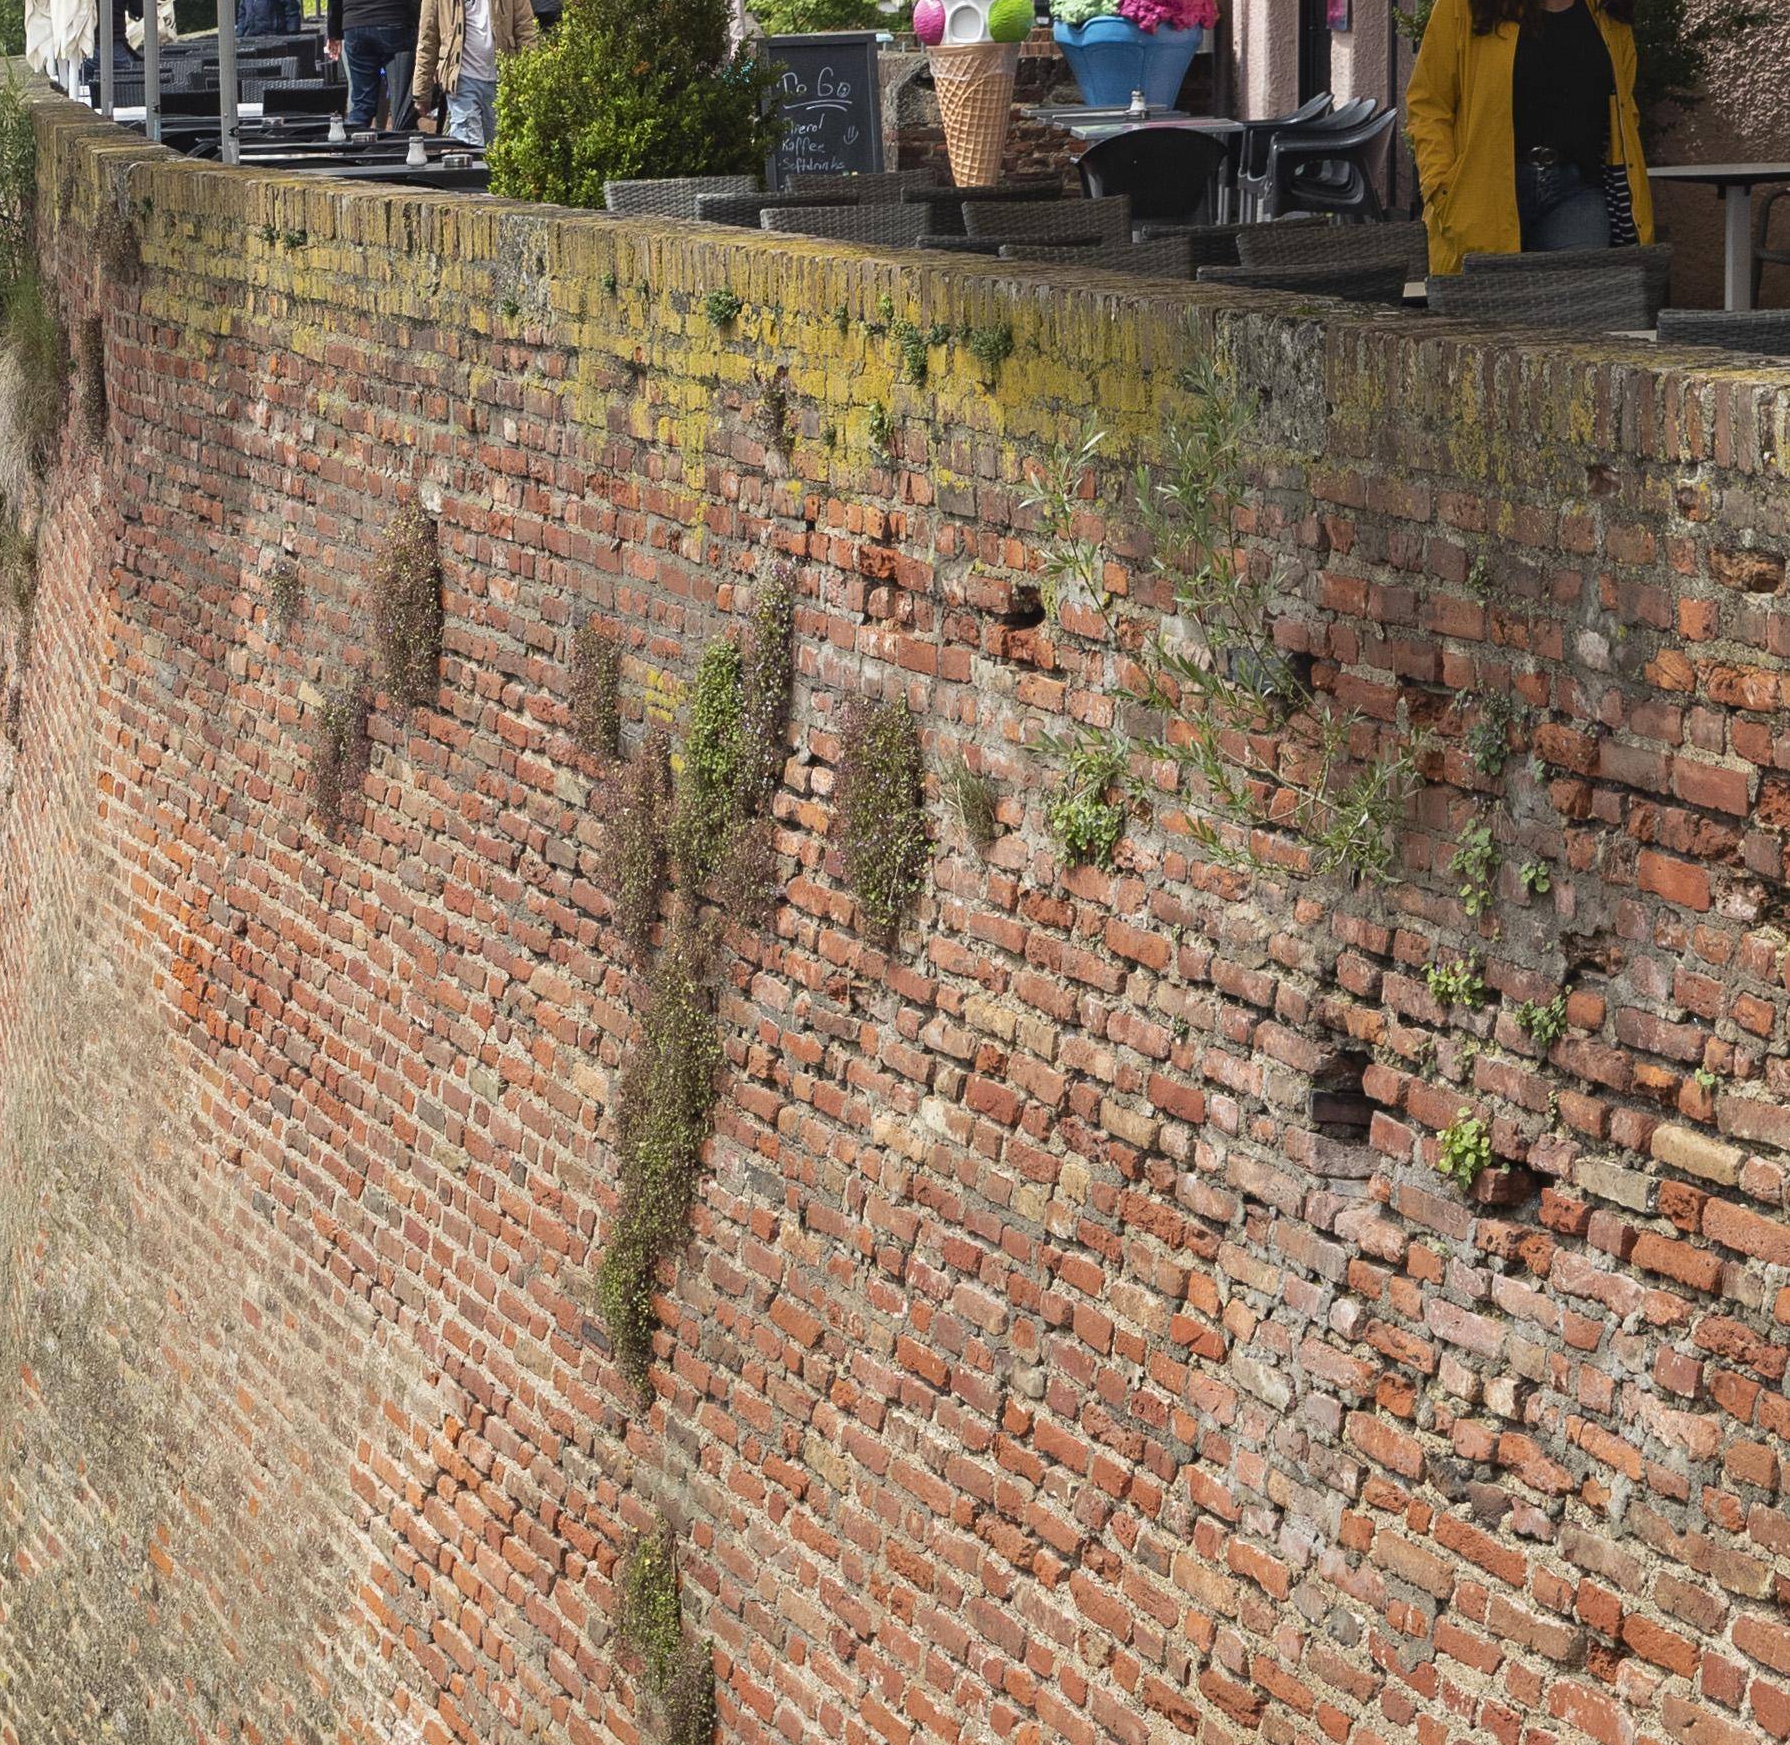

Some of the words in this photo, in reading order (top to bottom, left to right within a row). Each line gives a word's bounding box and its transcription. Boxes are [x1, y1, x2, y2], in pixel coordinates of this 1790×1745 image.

[777, 72, 807, 93] To
[818, 66, 851, 97] Go
[782, 136, 826, 156] Kaffee
